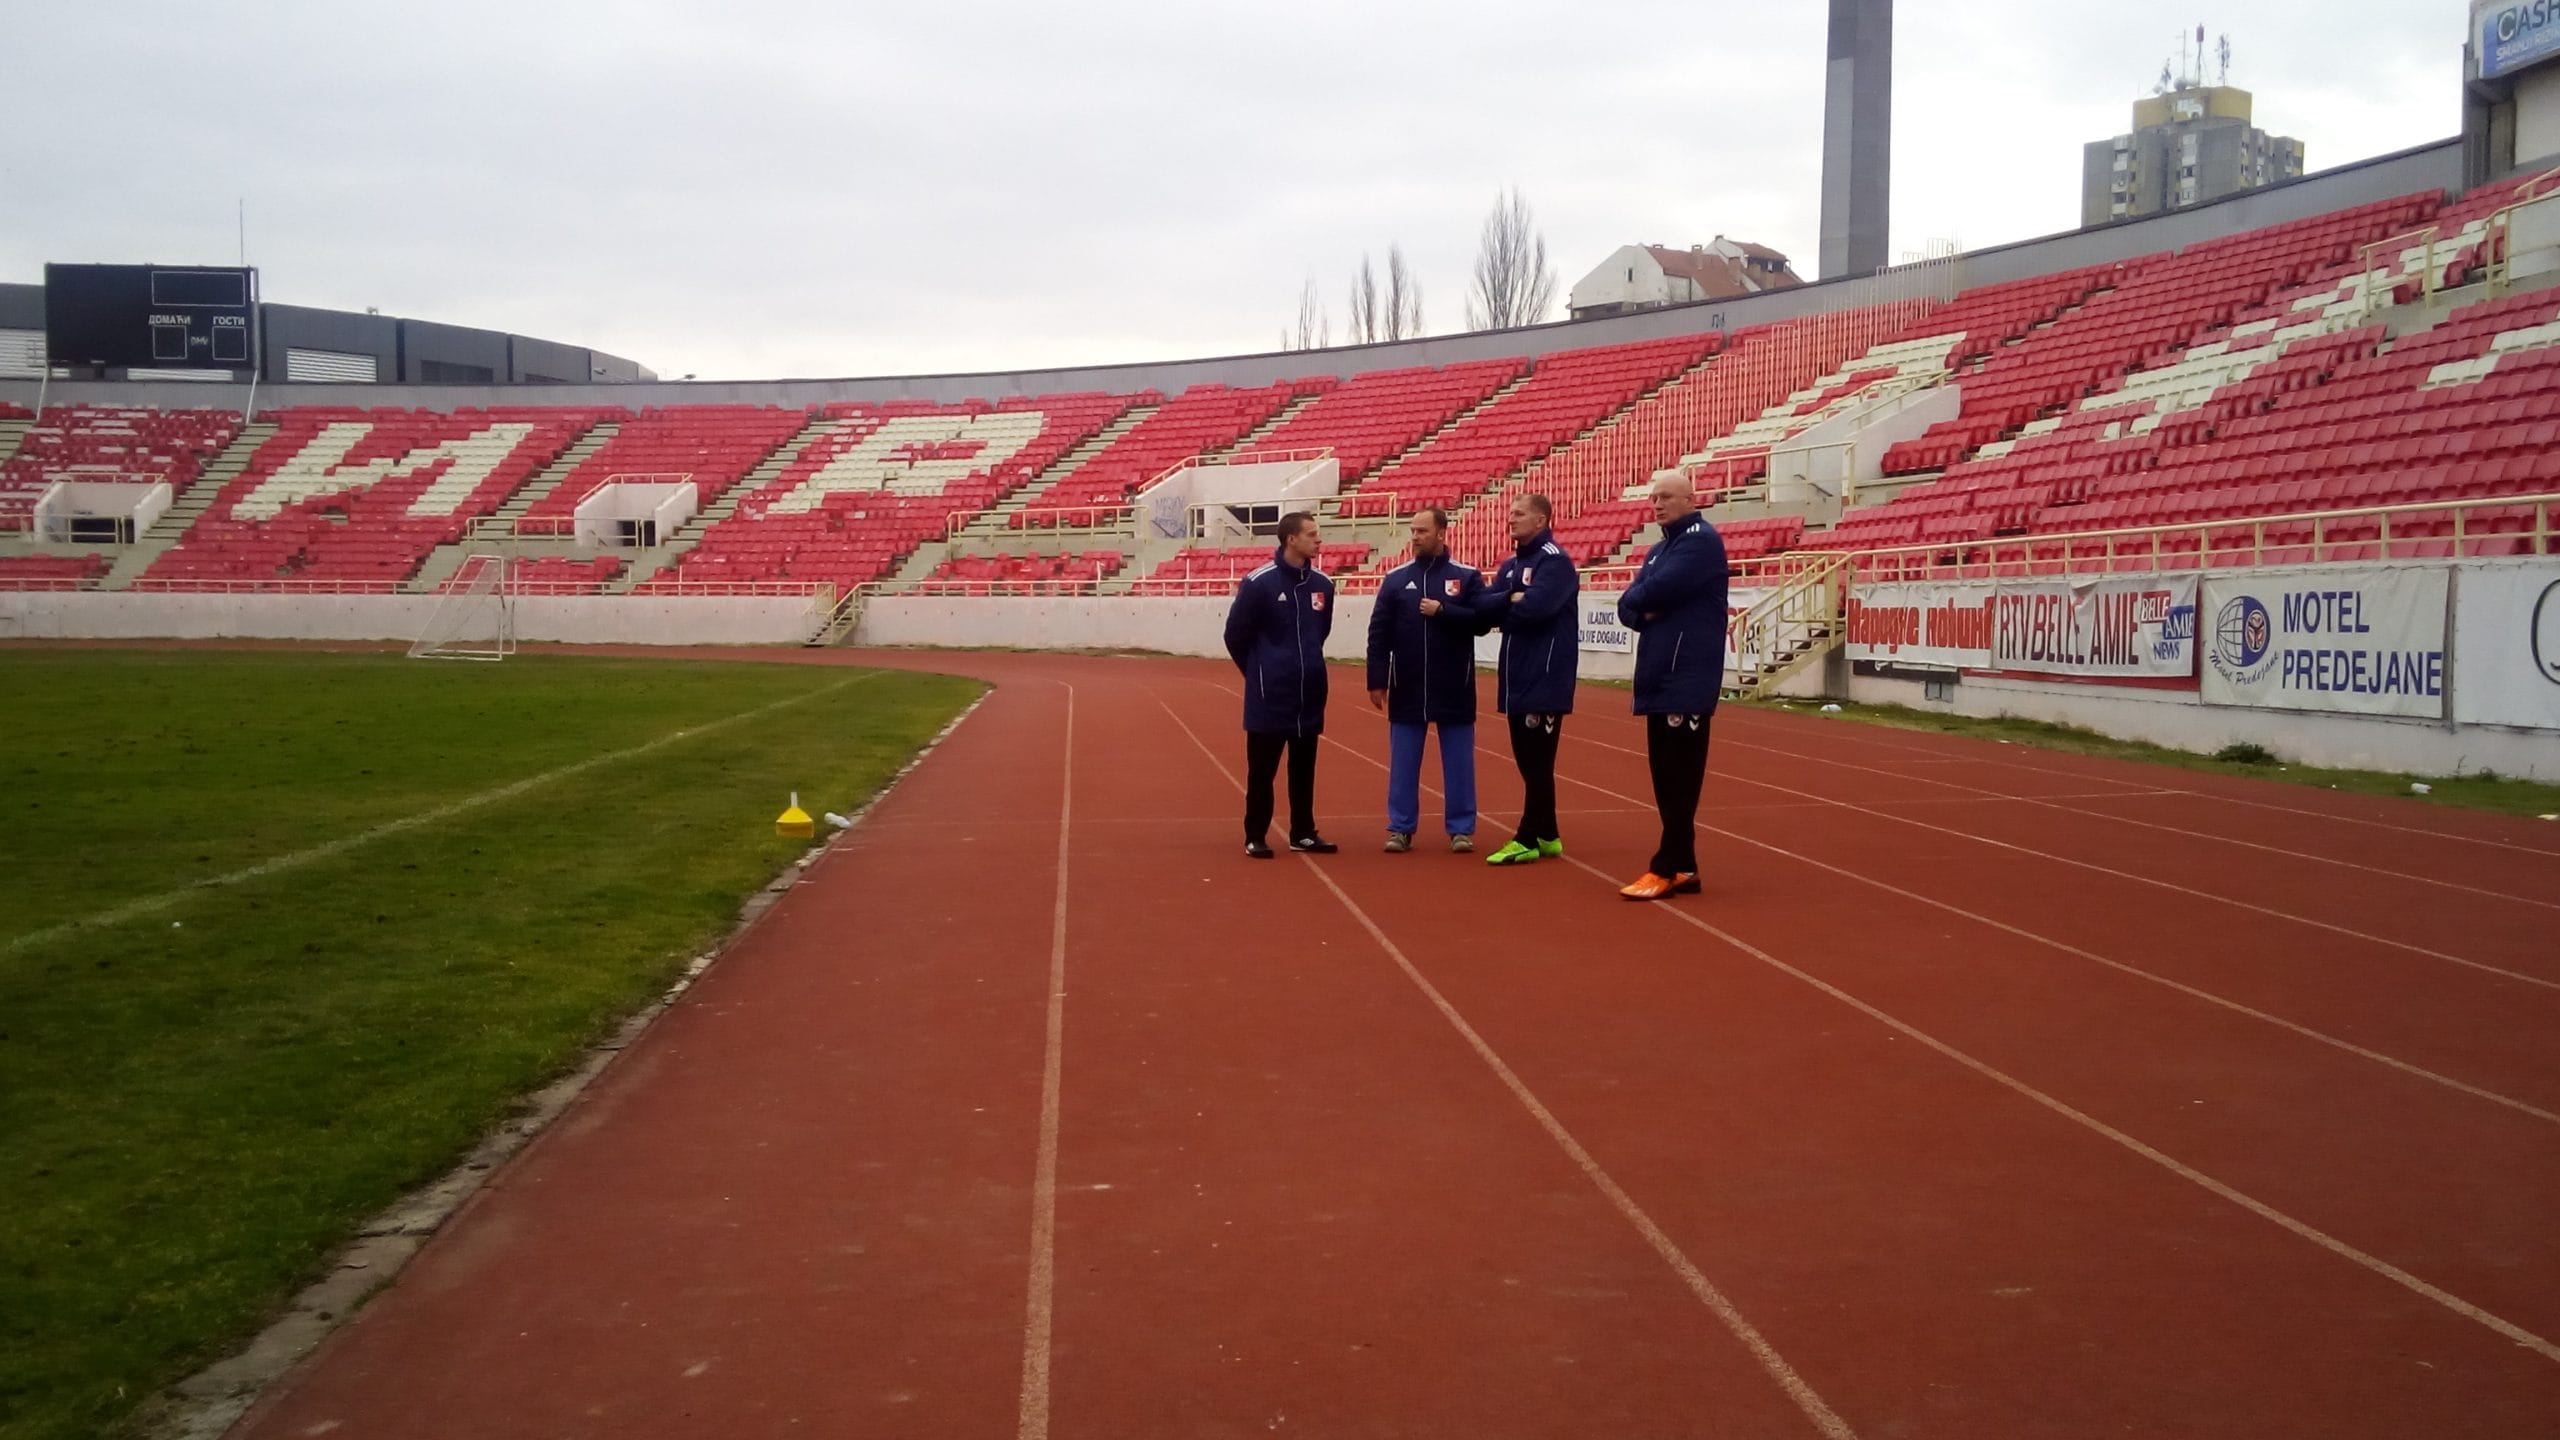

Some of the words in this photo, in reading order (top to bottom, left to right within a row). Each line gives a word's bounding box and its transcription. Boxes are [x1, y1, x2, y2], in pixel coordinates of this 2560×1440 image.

[213, 316, 245, 325] ГОСТИ
[2141, 595, 2171, 622] BELLE
[2283, 591, 2370, 634] MOTEL
[2000, 593, 2030, 660] RTV
[2090, 592, 2139, 666] AMIE
[2165, 612, 2194, 638] AMIE
[2152, 641, 2181, 661] NEWS
[2282, 649, 2443, 696] PREDEJANE
